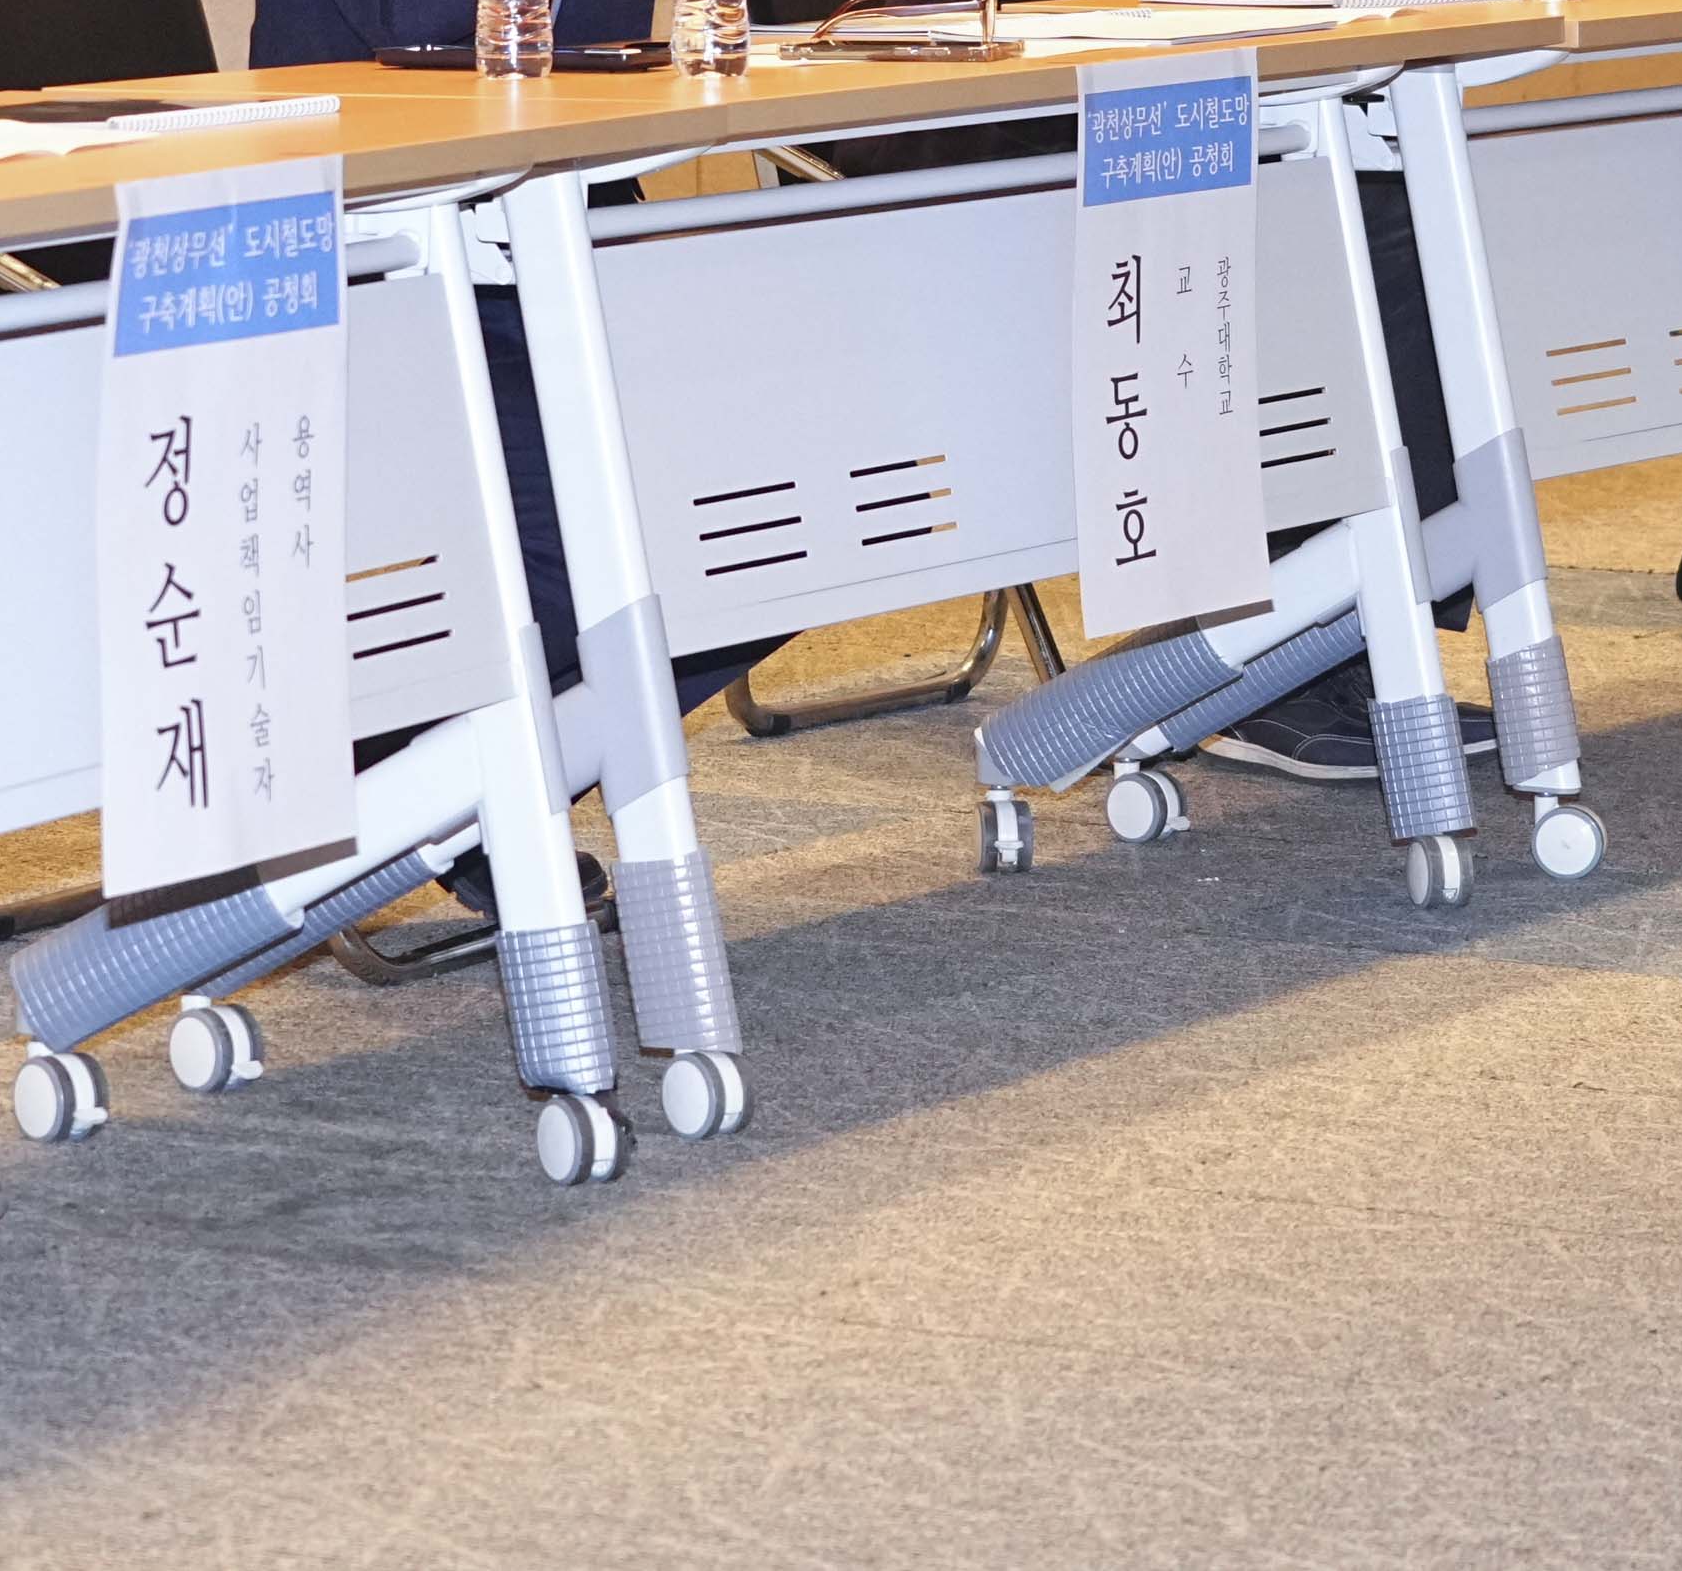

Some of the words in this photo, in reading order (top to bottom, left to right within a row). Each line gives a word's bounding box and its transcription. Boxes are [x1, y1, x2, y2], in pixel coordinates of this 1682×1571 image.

[1100, 147, 1182, 189] 구축계획(안)
[1189, 141, 1233, 177] 공청회
[1175, 93, 1250, 131] 도시철도망
[139, 281, 254, 334] 구축계획(안)
[263, 270, 318, 318] 공청회
[244, 212, 334, 259] 도시철도망
[1105, 253, 1157, 568] 최동호
[1215, 256, 1235, 417] 광주대학교
[291, 414, 316, 569] 용역사
[144, 414, 210, 809] 정순재
[238, 421, 275, 803] 사업책임기술자
